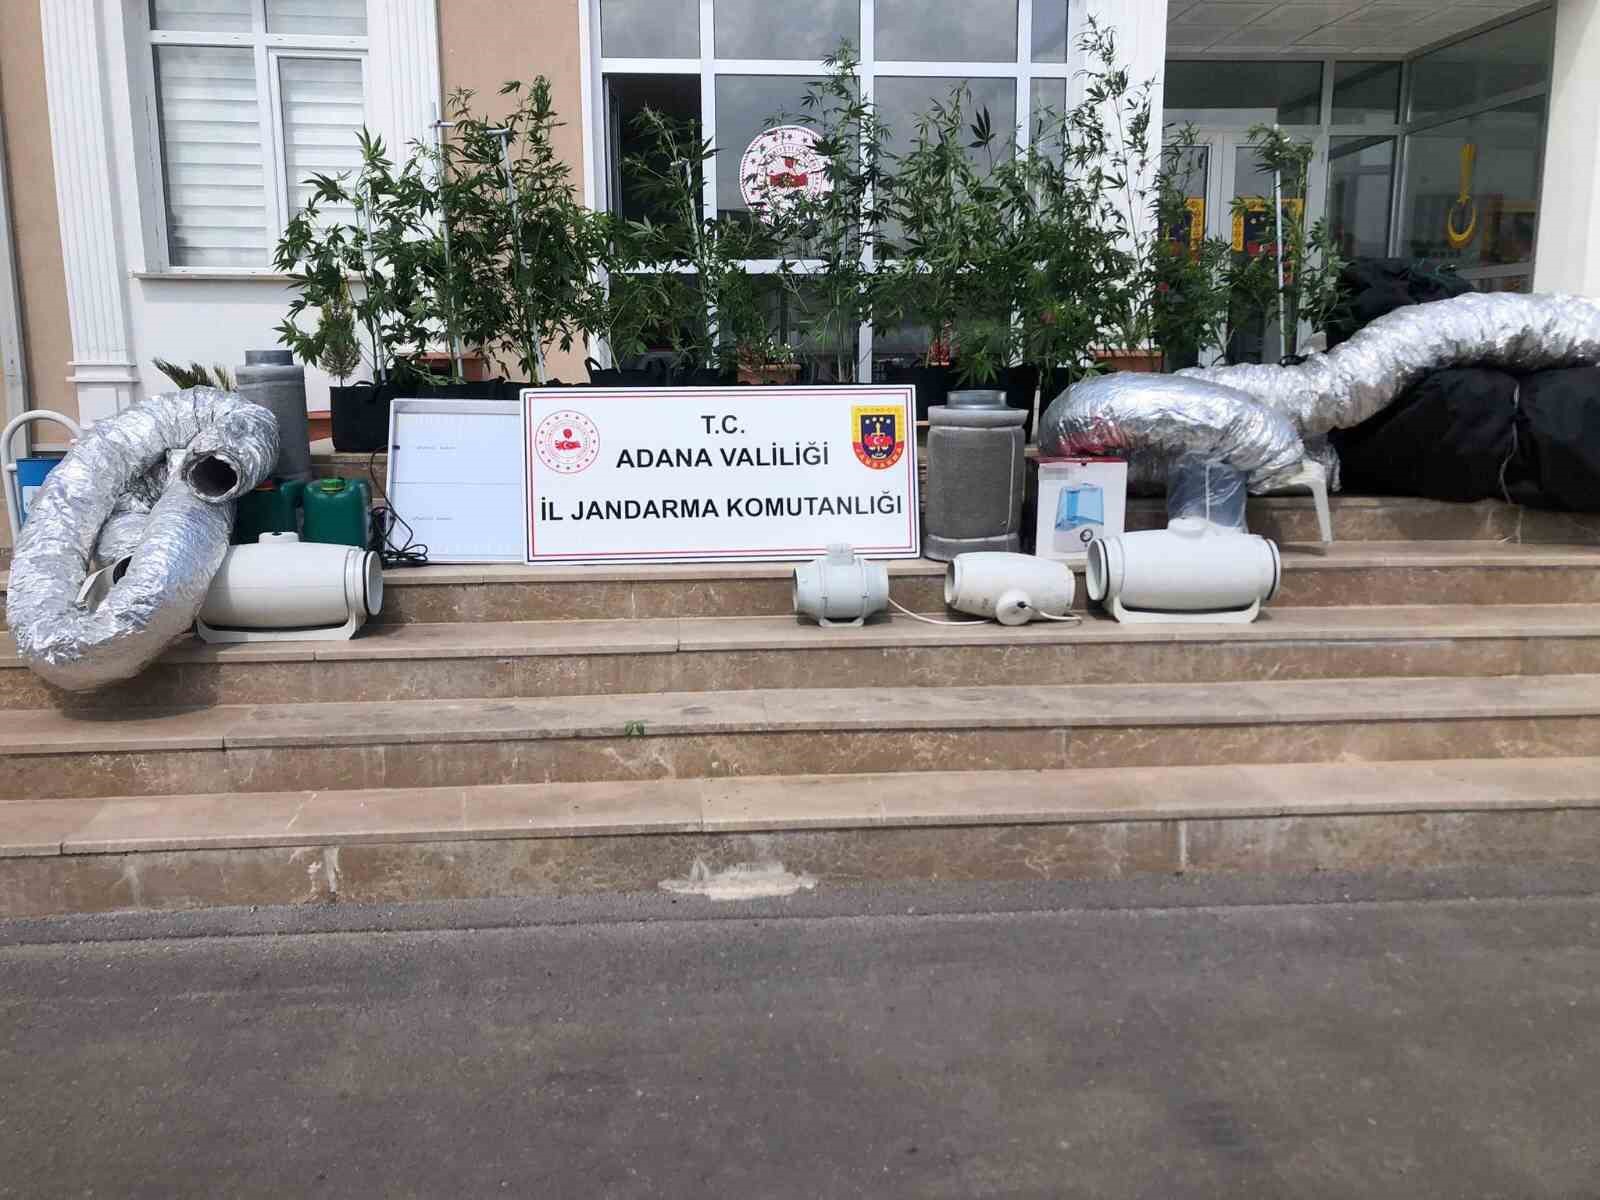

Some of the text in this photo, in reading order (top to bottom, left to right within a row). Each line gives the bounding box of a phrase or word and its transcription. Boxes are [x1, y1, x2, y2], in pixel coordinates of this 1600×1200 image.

[700, 414, 745, 435] T.C.
[615, 447, 713, 469] ADANA
[719, 441, 829, 467] VALİLİĞİ
[541, 490, 902, 521] İL JANDARMA KOMUTANLIĞI
